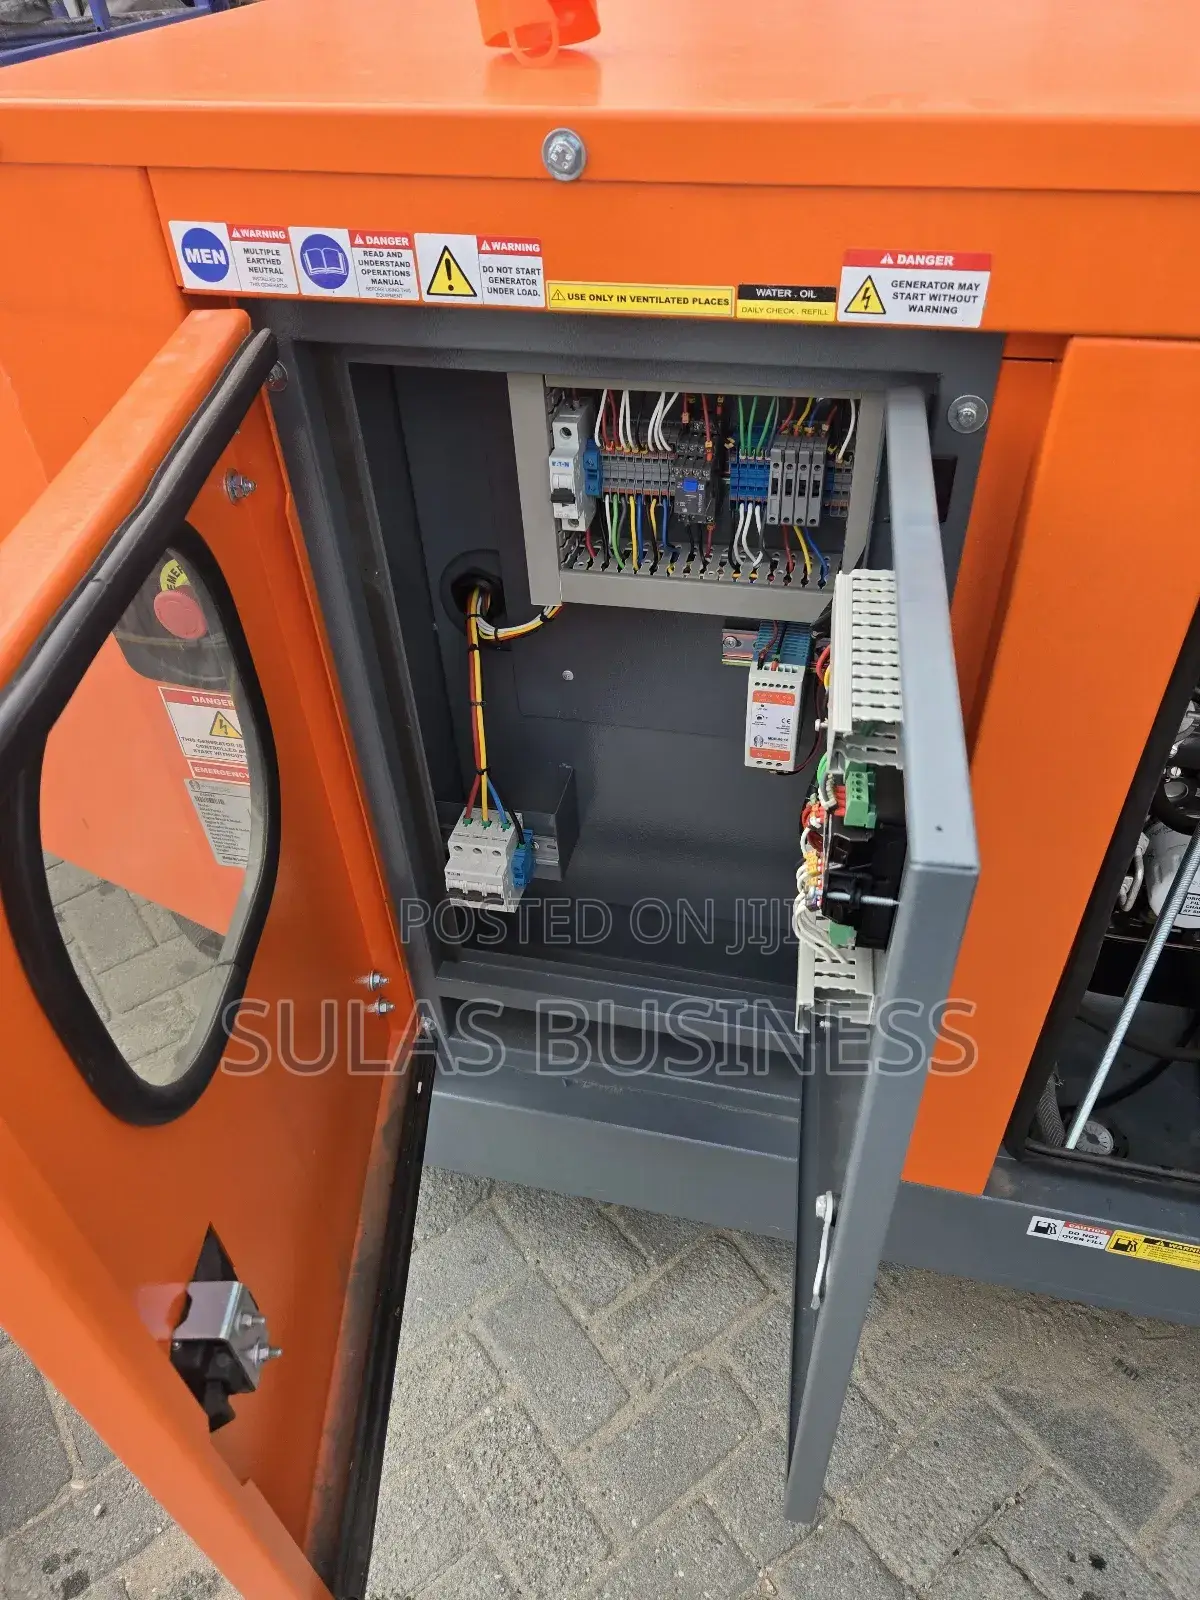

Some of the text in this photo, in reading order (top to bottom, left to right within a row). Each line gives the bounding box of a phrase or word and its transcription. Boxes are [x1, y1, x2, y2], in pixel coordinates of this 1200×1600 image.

[240, 228, 286, 240] WARNING
[365, 235, 410, 246] DANGER
[243, 247, 281, 256] MULTIPLE
[491, 242, 541, 252] WARNING
[184, 248, 227, 265] MEN
[363, 250, 403, 259] READ AND
[246, 257, 282, 266] EARTHED
[358, 260, 411, 268] UNDERSTAND
[897, 254, 954, 266] DANGER
[248, 266, 284, 275] NEUTRAL
[361, 268, 411, 278] OPERATIONS
[482, 265, 542, 276] DO NOT START
[371, 278, 404, 286] MANUAL
[488, 276, 538, 286] GENERATOR
[891, 280, 980, 292] GENERATOR MAY
[487, 286, 541, 297] UNDER LOAD.
[755, 288, 817, 298] WATER OIL
[567, 293, 586, 301] USE
[589, 294, 614, 302] ONLY
[630, 296, 690, 305] VENTILATED
[692, 298, 730, 306] PLACES
[892, 292, 978, 304] START WITHOUT
[741, 306, 830, 316] DAILY CHECK REFILL
[908, 304, 958, 314] WARNING
[192, 695, 234, 707] DANGER
[1068, 1223, 1108, 1234] CAUTION
